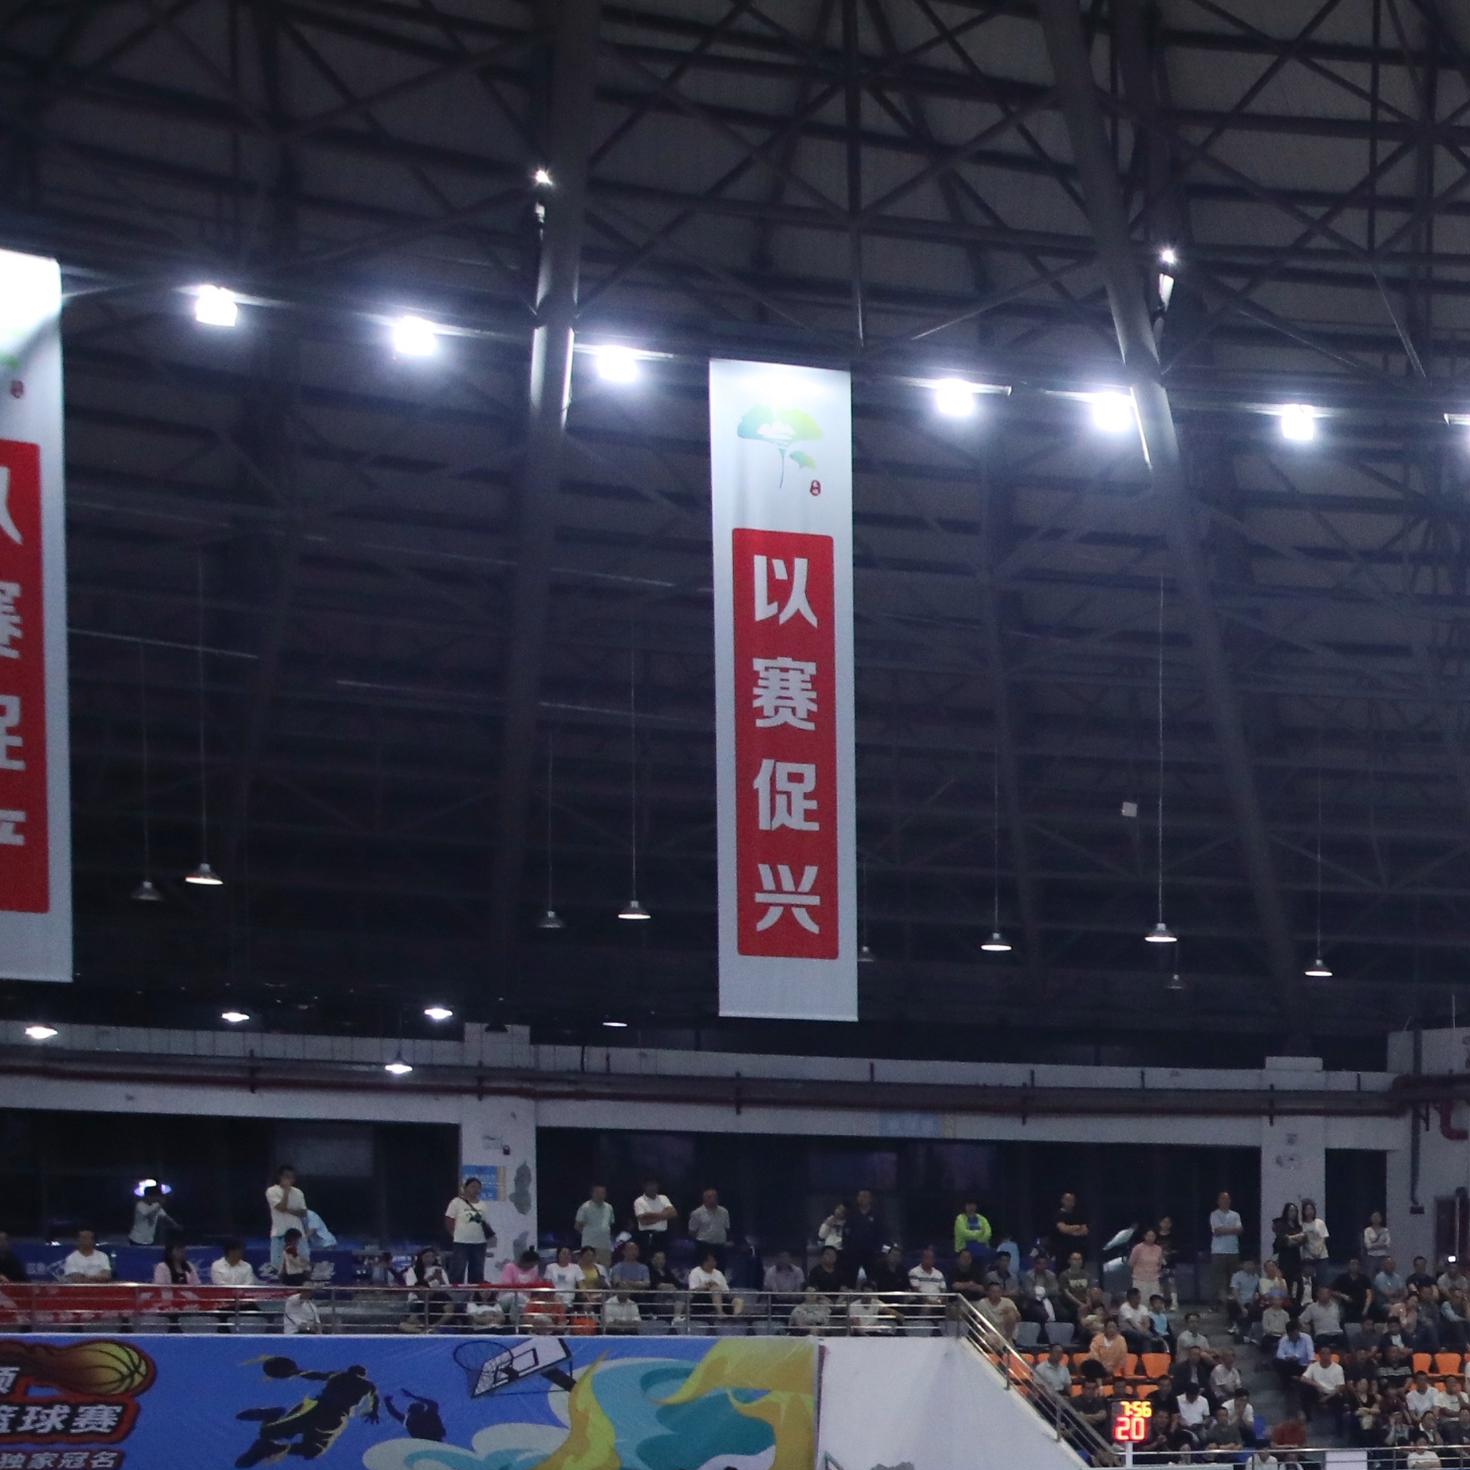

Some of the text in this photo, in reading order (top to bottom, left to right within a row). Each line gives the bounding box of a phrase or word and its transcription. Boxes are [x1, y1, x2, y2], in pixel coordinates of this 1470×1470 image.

[752, 554, 821, 935] 以赛促兴
[1115, 1417, 1147, 1441] 20
